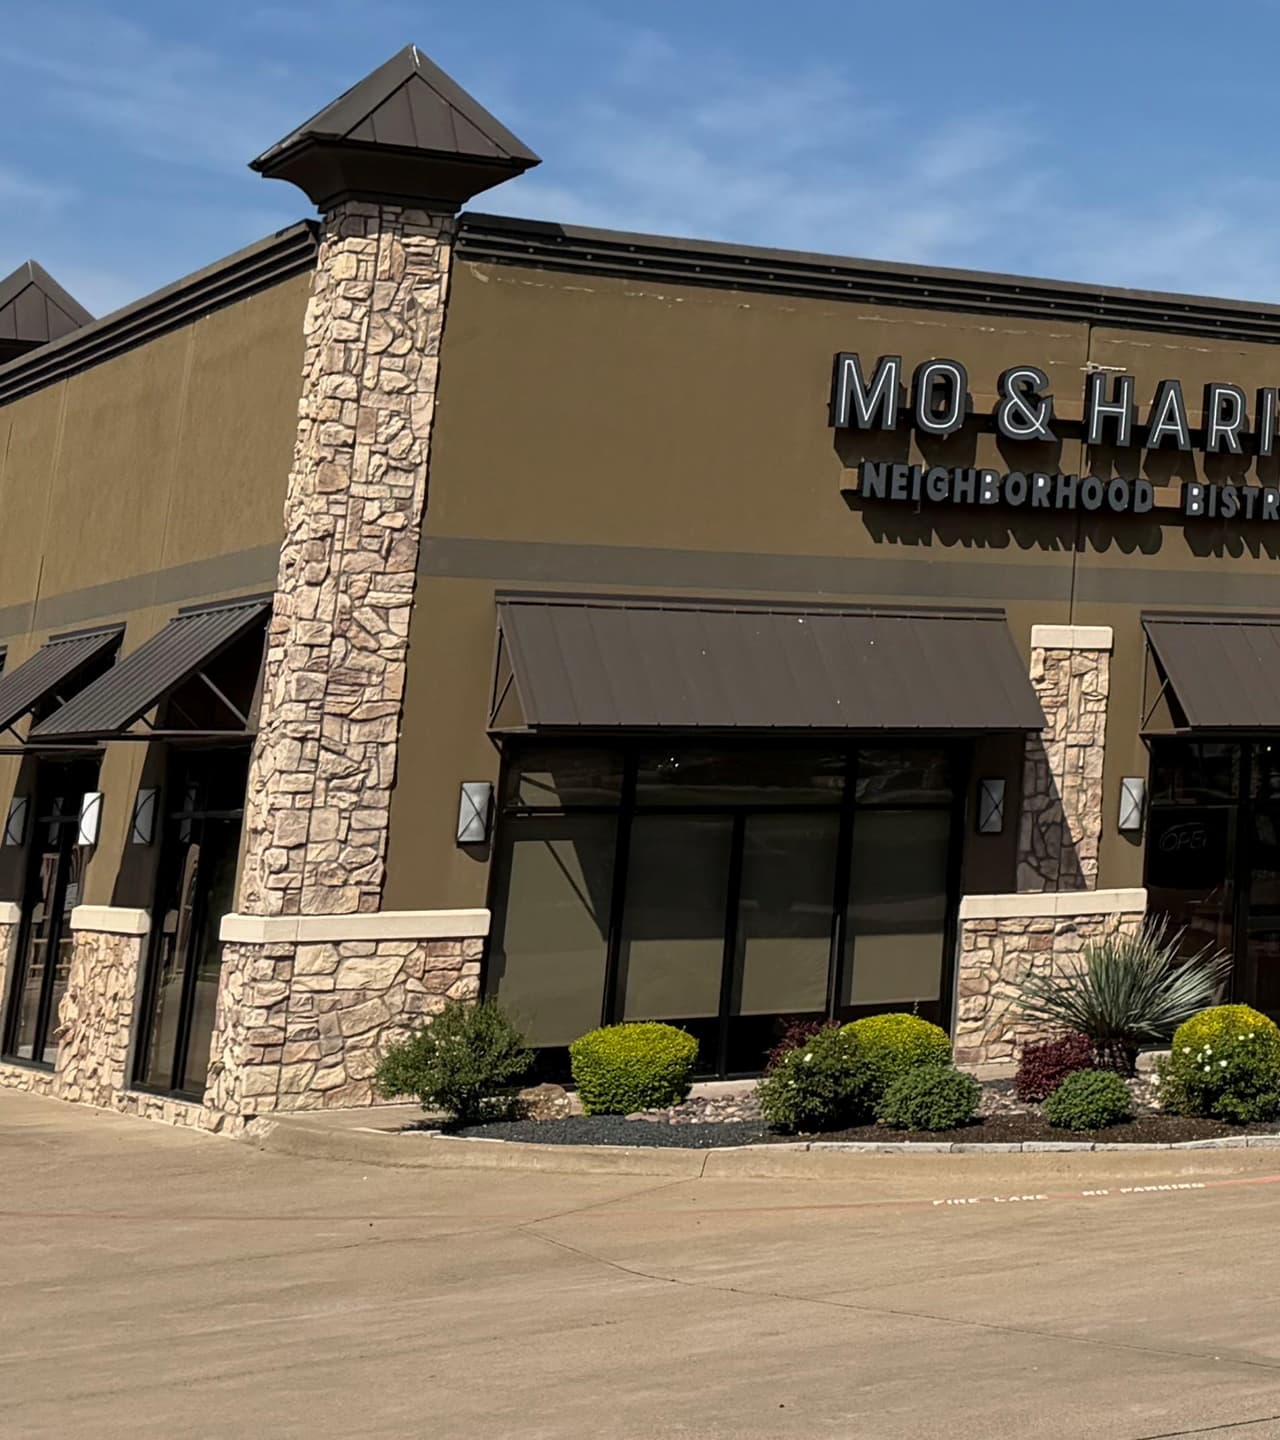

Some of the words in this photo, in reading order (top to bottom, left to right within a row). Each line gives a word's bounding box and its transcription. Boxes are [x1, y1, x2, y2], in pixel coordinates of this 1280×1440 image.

[833, 352, 968, 434] MO
[998, 366, 1057, 441] &
[860, 460, 1153, 513] NEIGHBORHOOD
